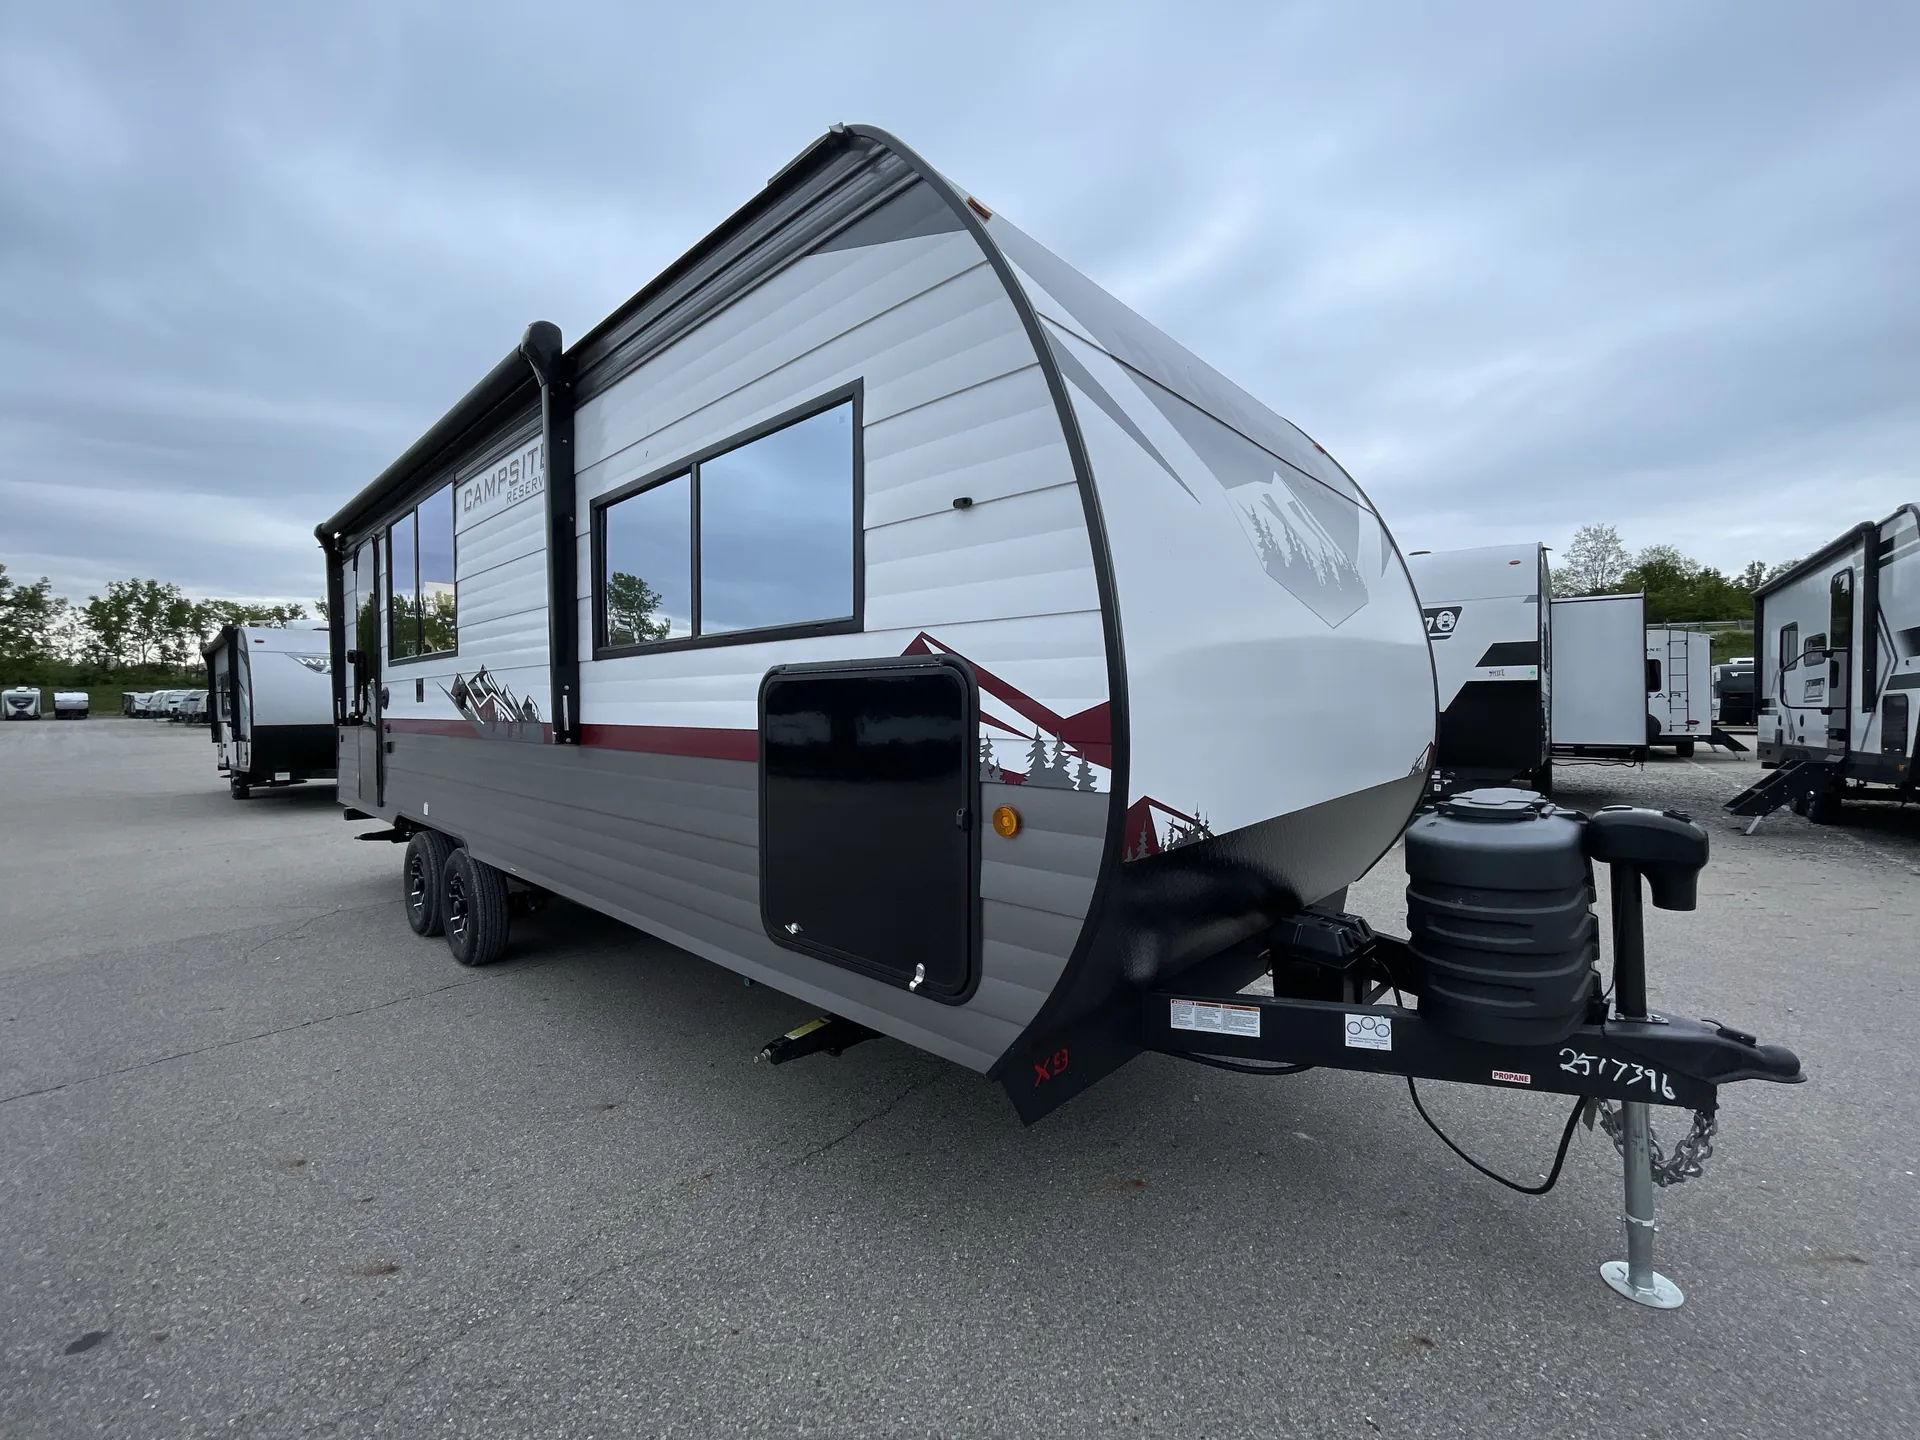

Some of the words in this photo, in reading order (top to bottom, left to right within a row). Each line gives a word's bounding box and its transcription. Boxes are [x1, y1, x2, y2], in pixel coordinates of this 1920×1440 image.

[506, 474, 545, 505] RESERV
[1493, 1072, 1530, 1083] PROPANE
[1559, 1048, 1676, 1100] 2517396
